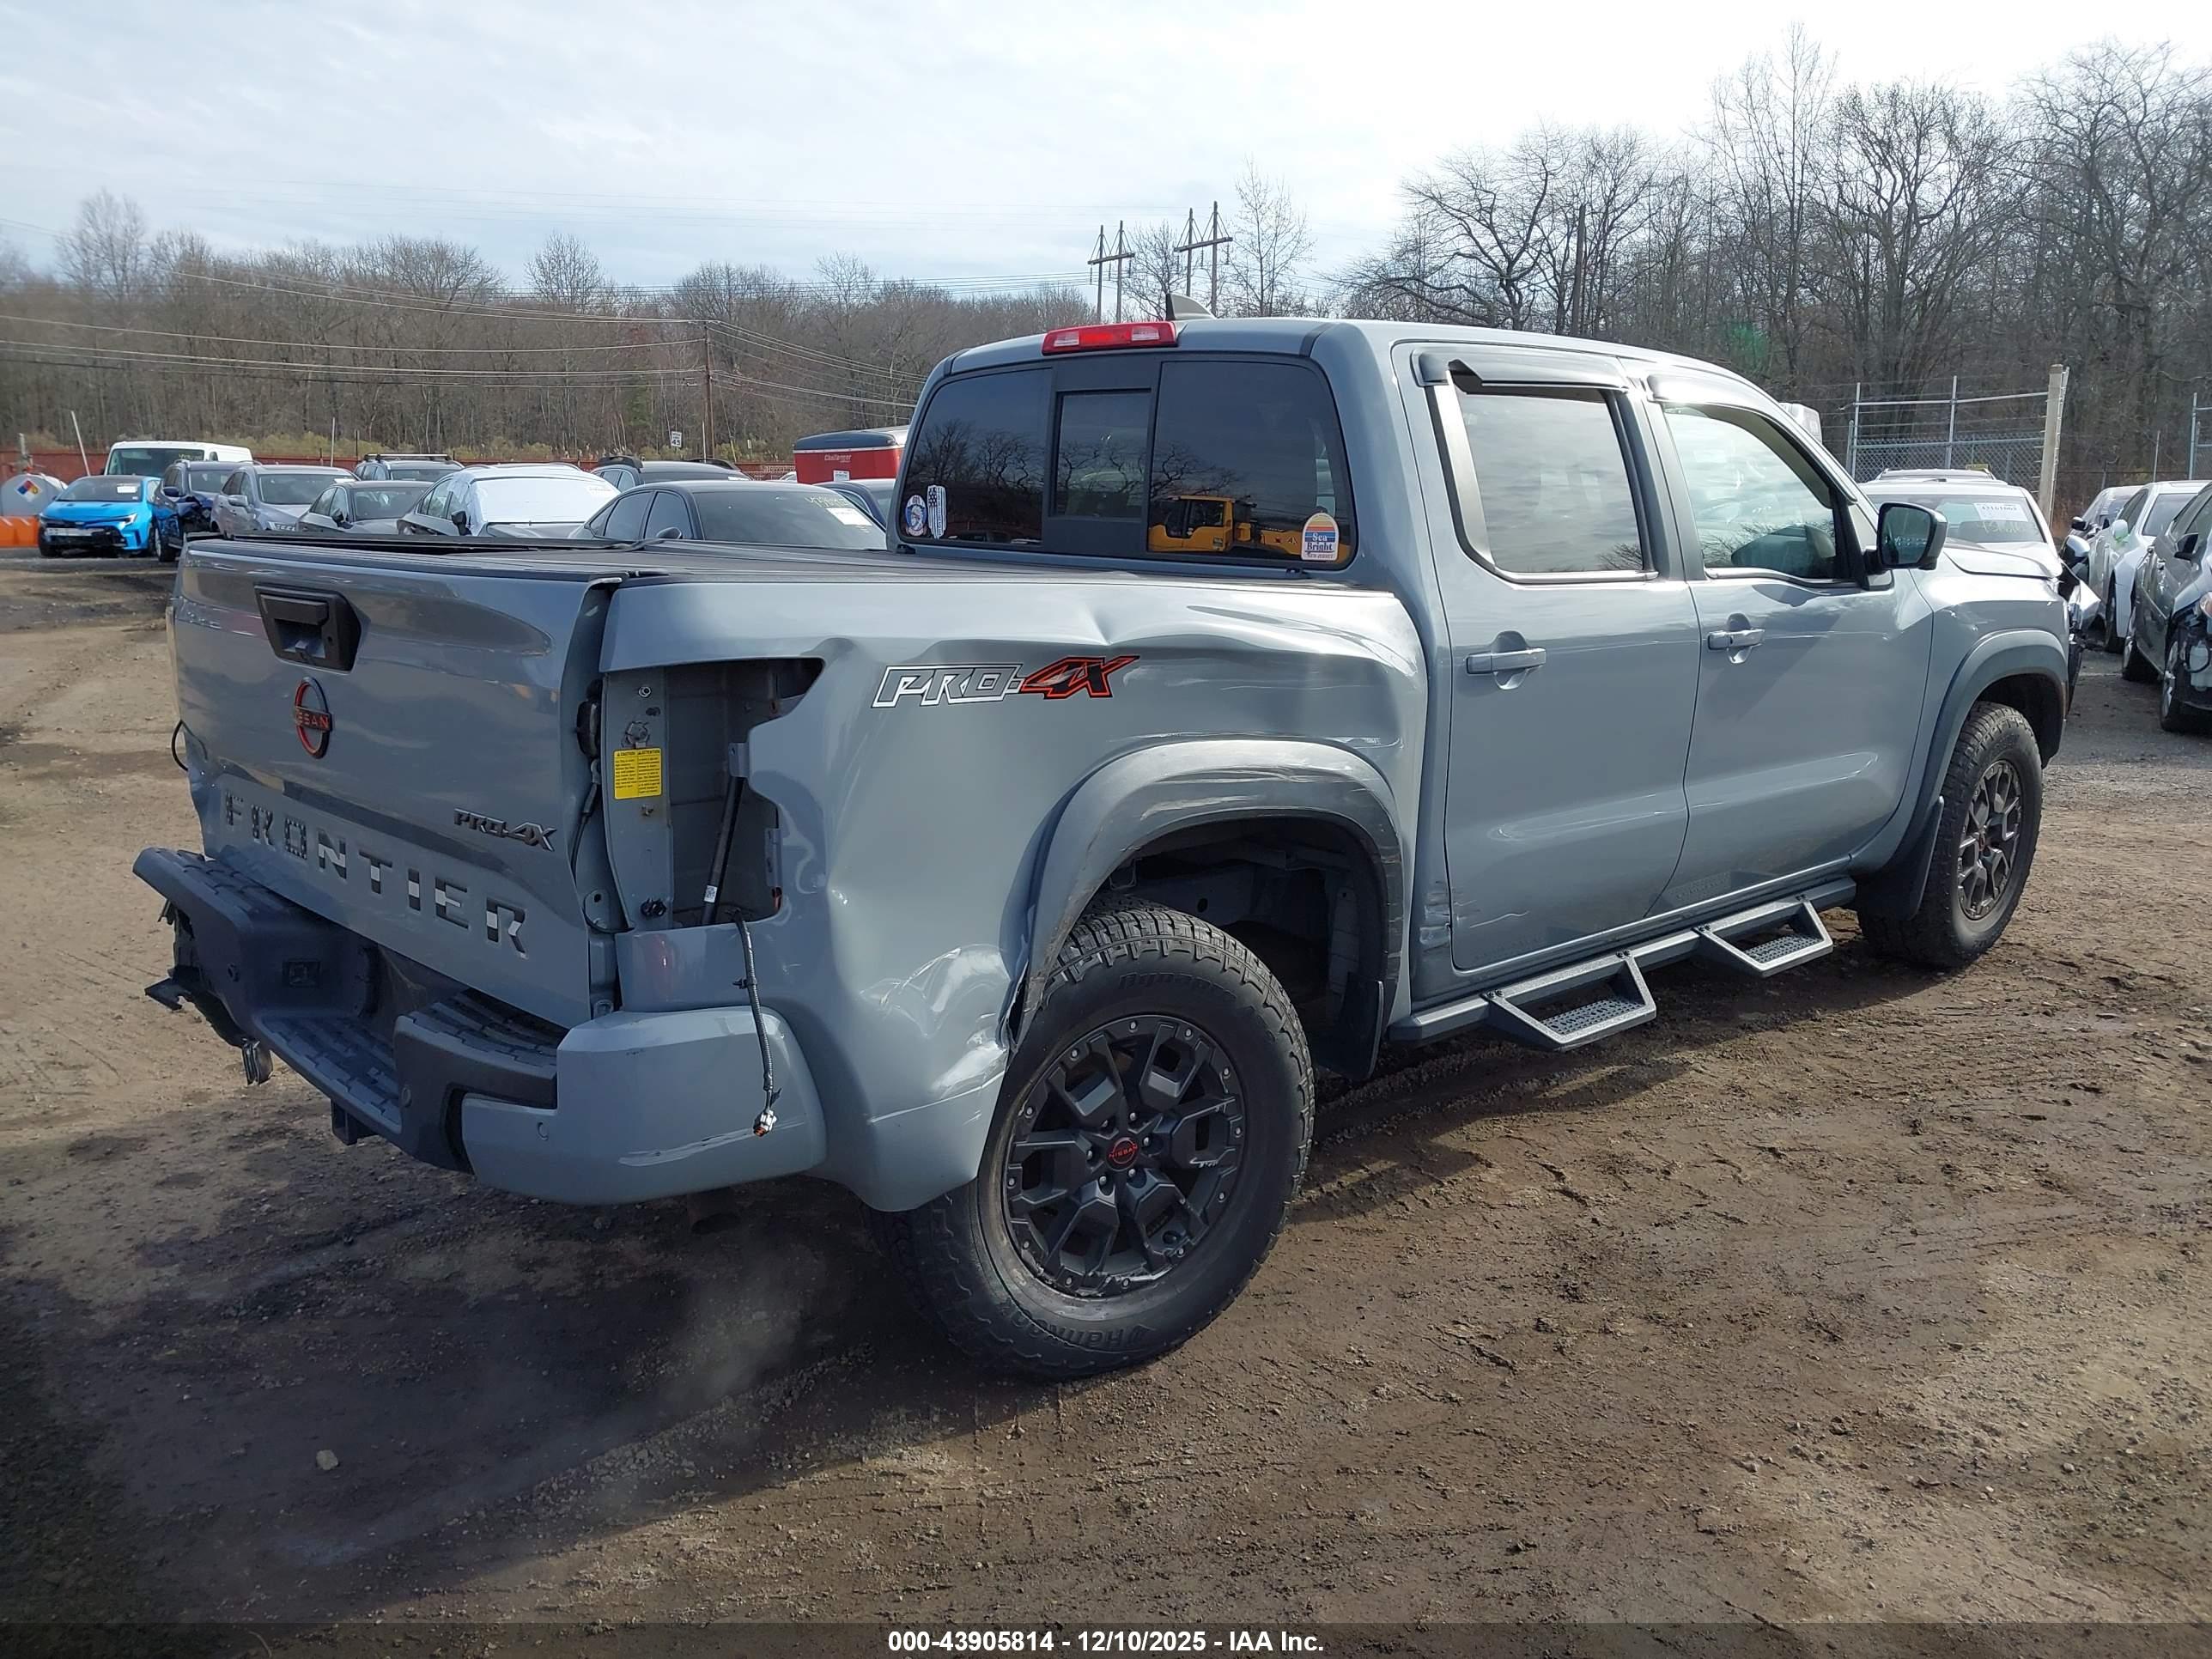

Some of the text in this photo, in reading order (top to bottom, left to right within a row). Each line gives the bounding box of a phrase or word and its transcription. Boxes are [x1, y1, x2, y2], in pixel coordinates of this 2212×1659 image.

[1307, 542, 1333, 552] Bright
[1312, 532, 1328, 541] Sea
[871, 655, 1140, 708] PRO-4X
[453, 808, 557, 852] PRO-4X
[226, 789, 529, 960] FRONTIER
